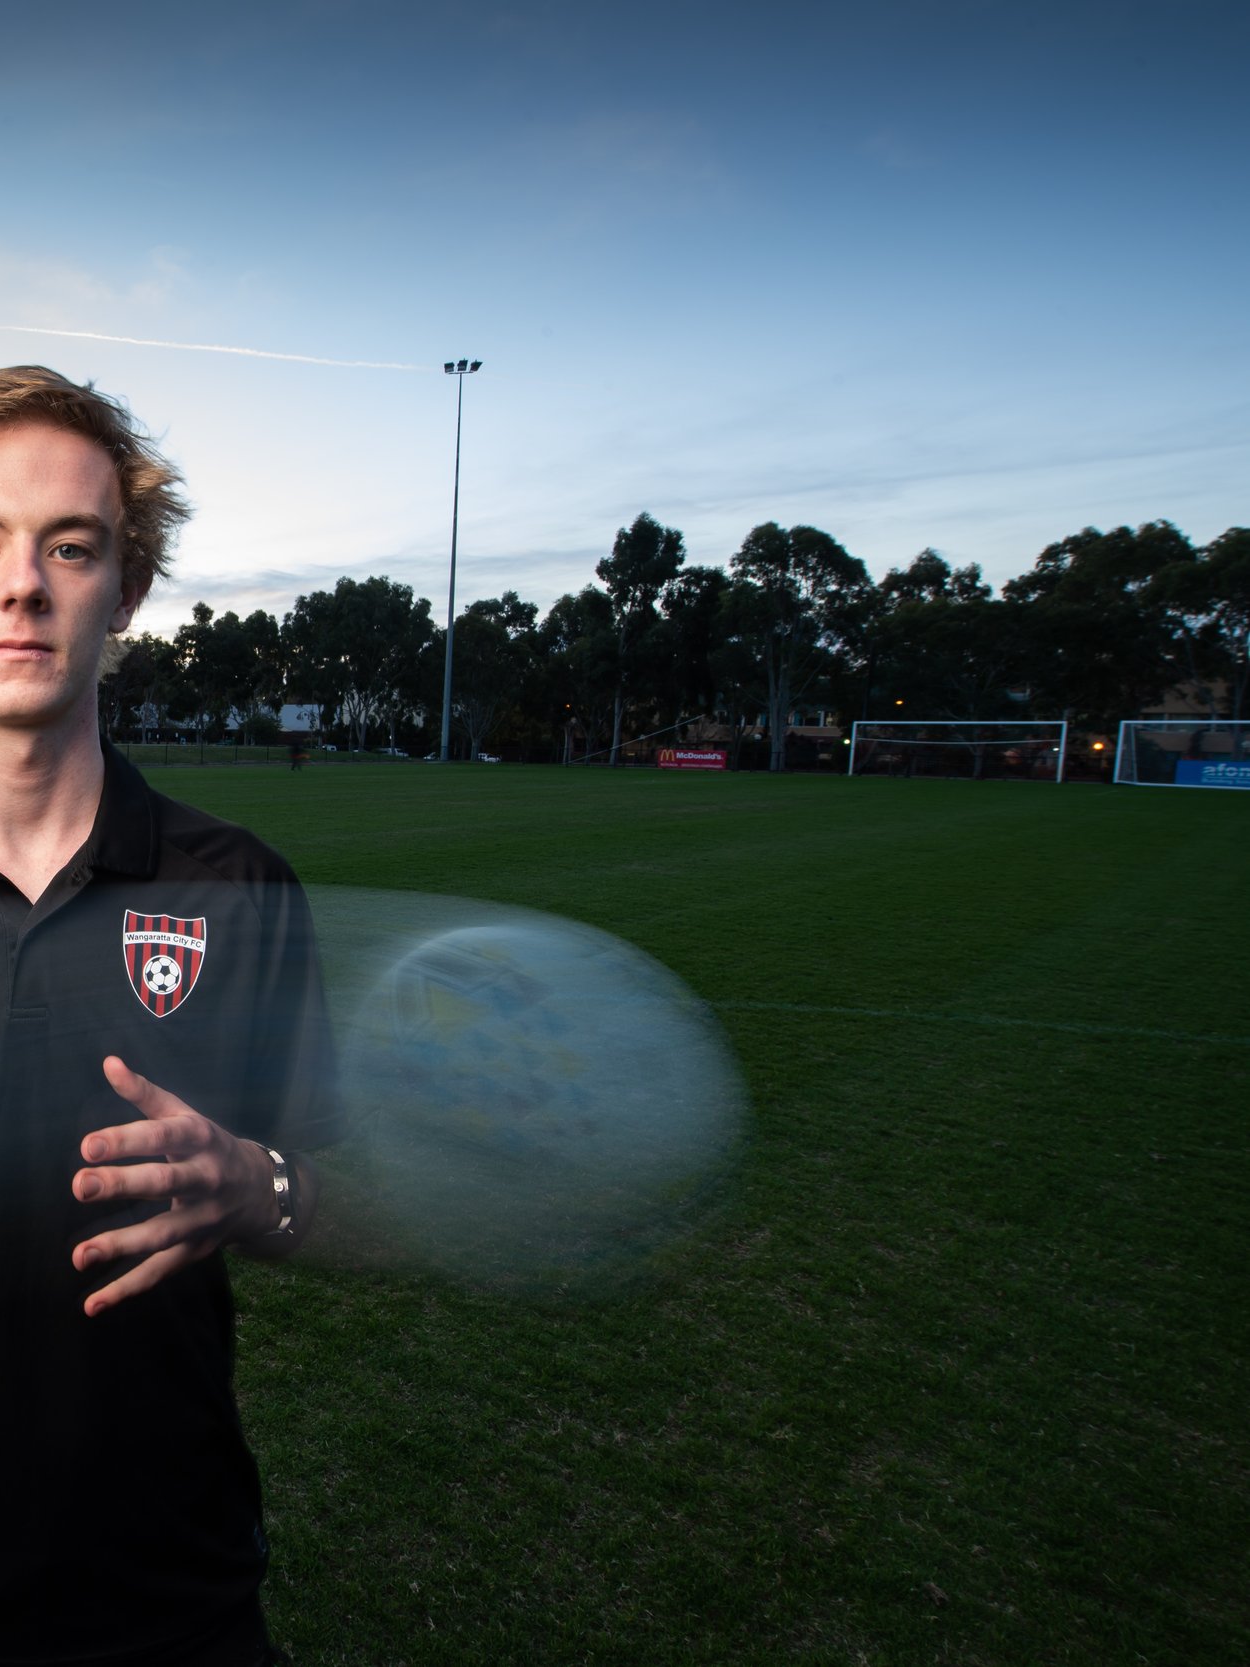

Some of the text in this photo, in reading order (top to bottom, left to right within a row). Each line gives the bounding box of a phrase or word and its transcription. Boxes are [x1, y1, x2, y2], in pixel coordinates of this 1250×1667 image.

[126, 934, 202, 948] Wangaratta City FC
